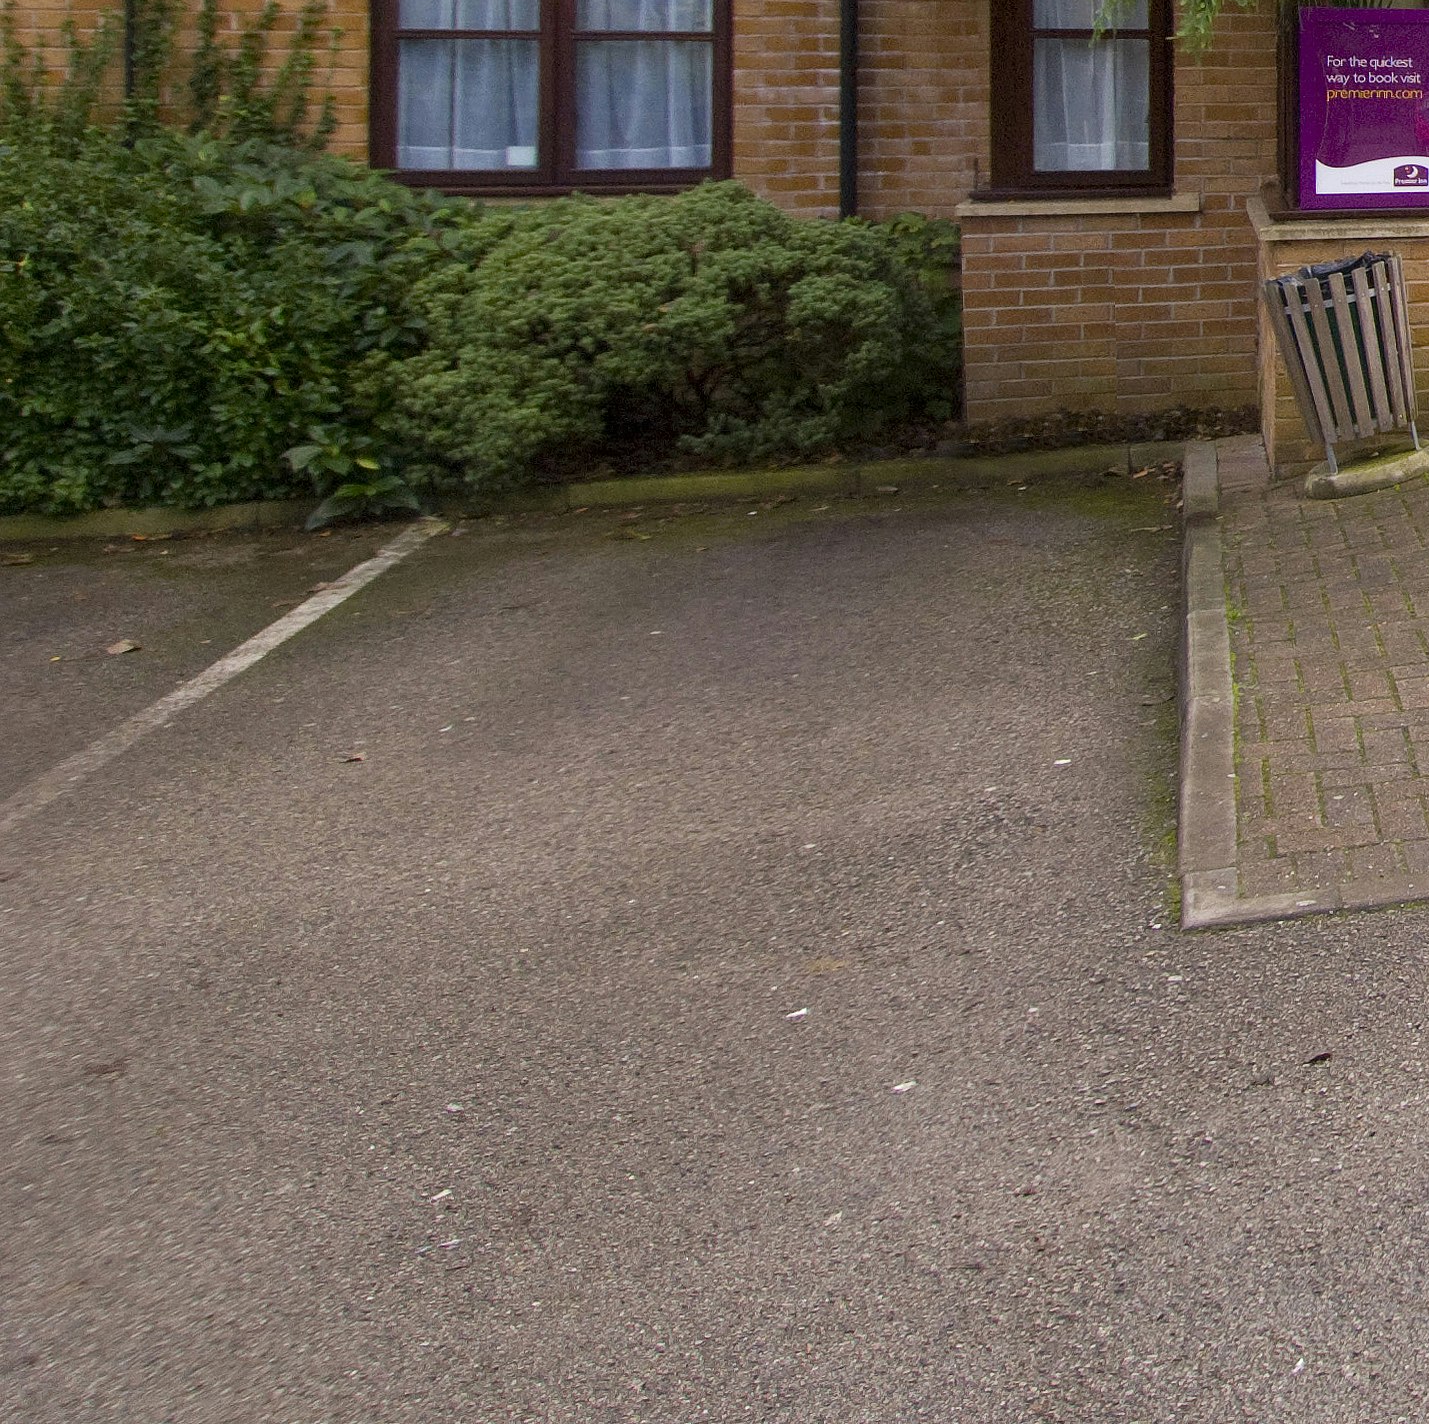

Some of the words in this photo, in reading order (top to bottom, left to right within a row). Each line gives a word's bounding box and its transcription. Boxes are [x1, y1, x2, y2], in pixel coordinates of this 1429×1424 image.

[1327, 55, 1346, 67] For
[1348, 55, 1367, 68] the
[1370, 56, 1413, 70] quickest
[1326, 75, 1350, 85] way
[1353, 73, 1366, 83] to
[1368, 72, 1398, 83] book
[1400, 72, 1421, 83] visit
[1326, 86, 1423, 102] premierinn.com
